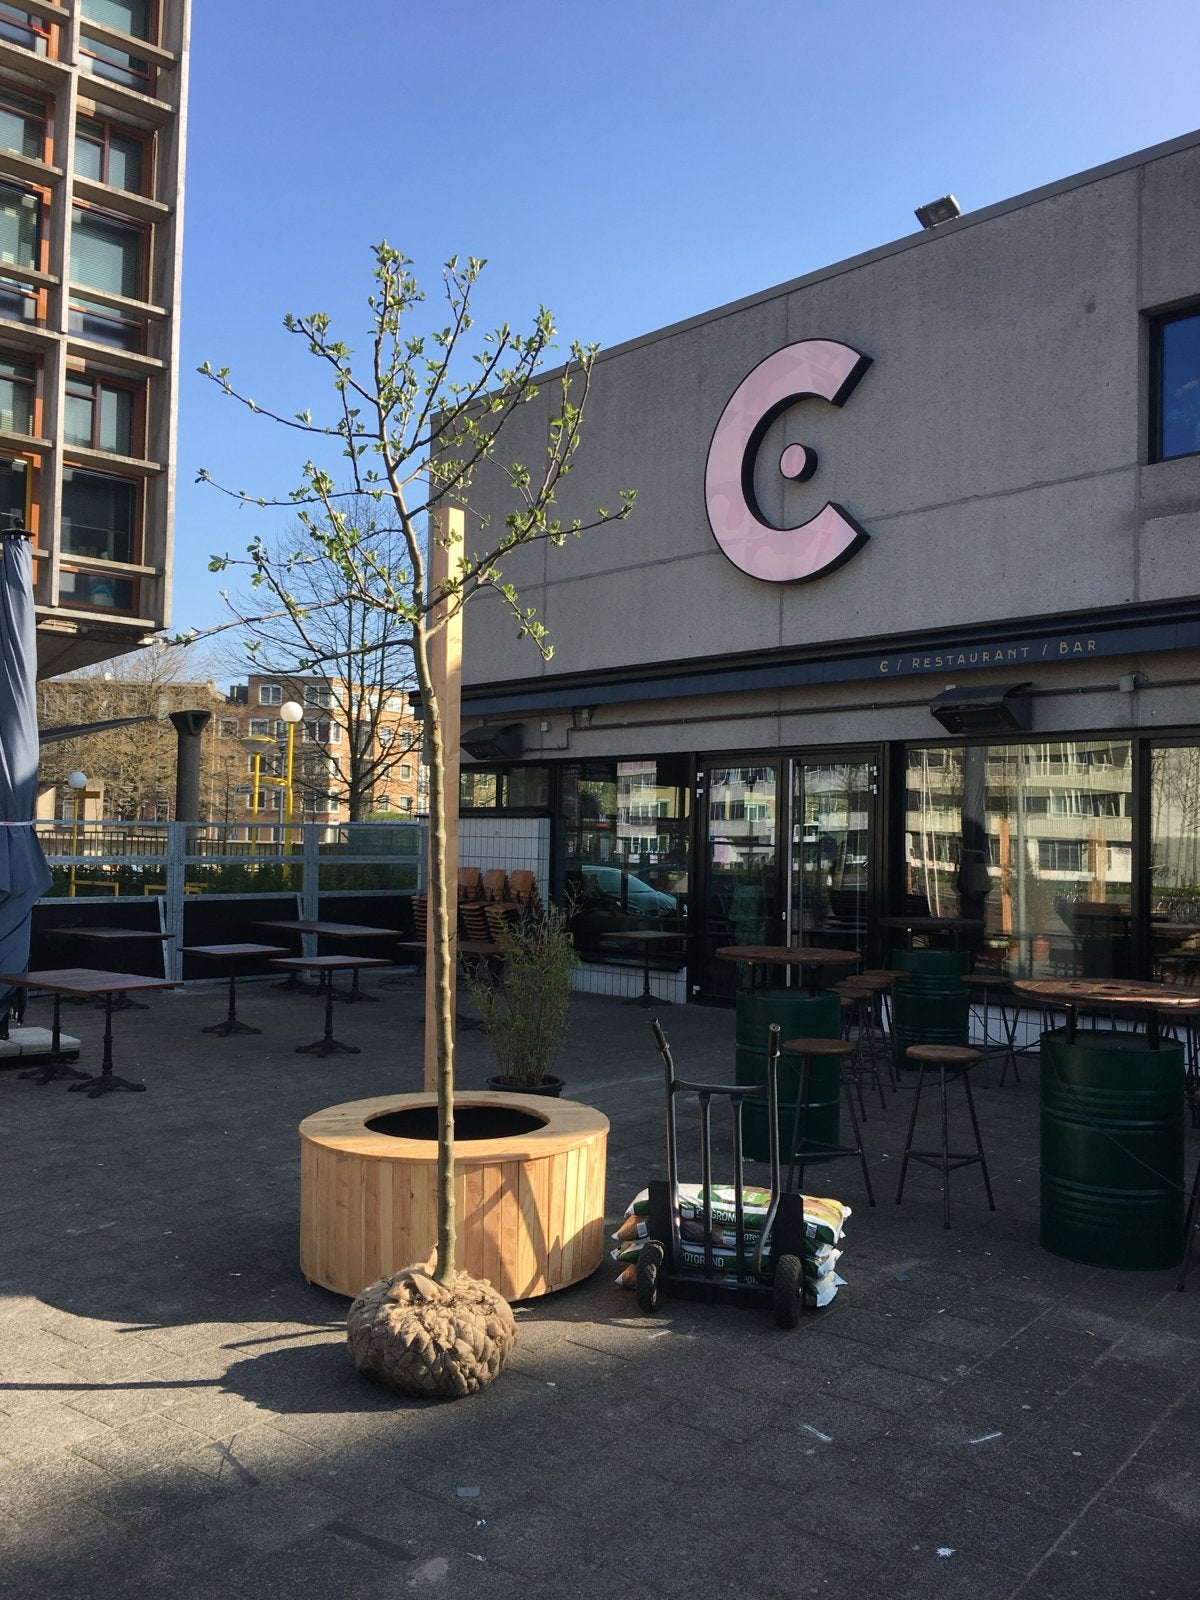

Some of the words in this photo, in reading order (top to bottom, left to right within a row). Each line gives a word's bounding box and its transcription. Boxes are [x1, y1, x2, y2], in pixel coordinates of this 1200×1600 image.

[704, 338, 874, 585] C
[912, 647, 1029, 669] RESTAURANT
[1059, 640, 1097, 654] BAR
